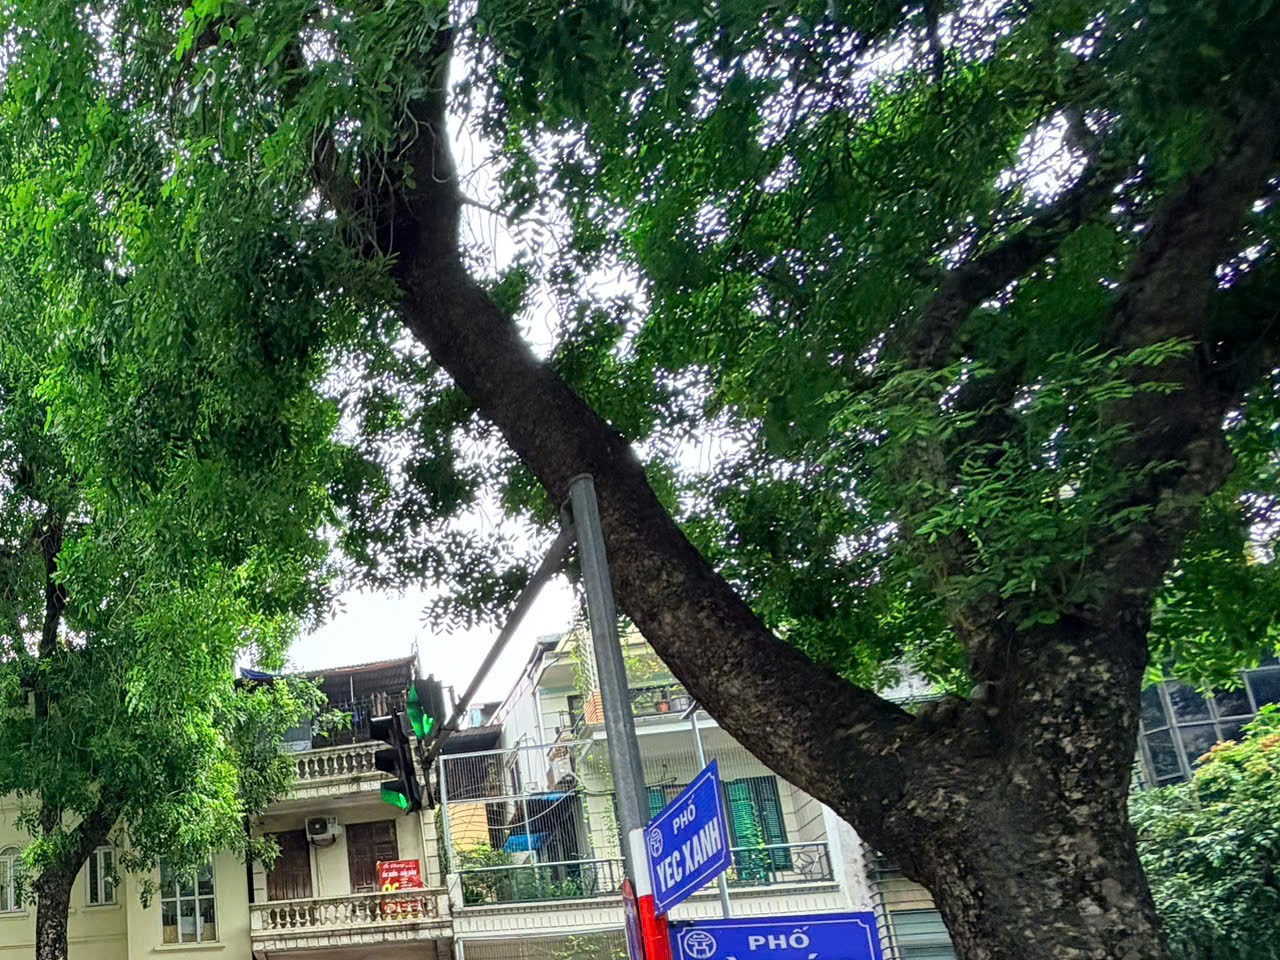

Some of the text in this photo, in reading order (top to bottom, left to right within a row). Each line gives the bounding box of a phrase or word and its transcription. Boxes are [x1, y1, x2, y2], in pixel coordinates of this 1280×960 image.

[672, 795, 697, 835] PHỐ
[656, 816, 722, 893] YEC XANH
[748, 926, 810, 951] PHỐ
